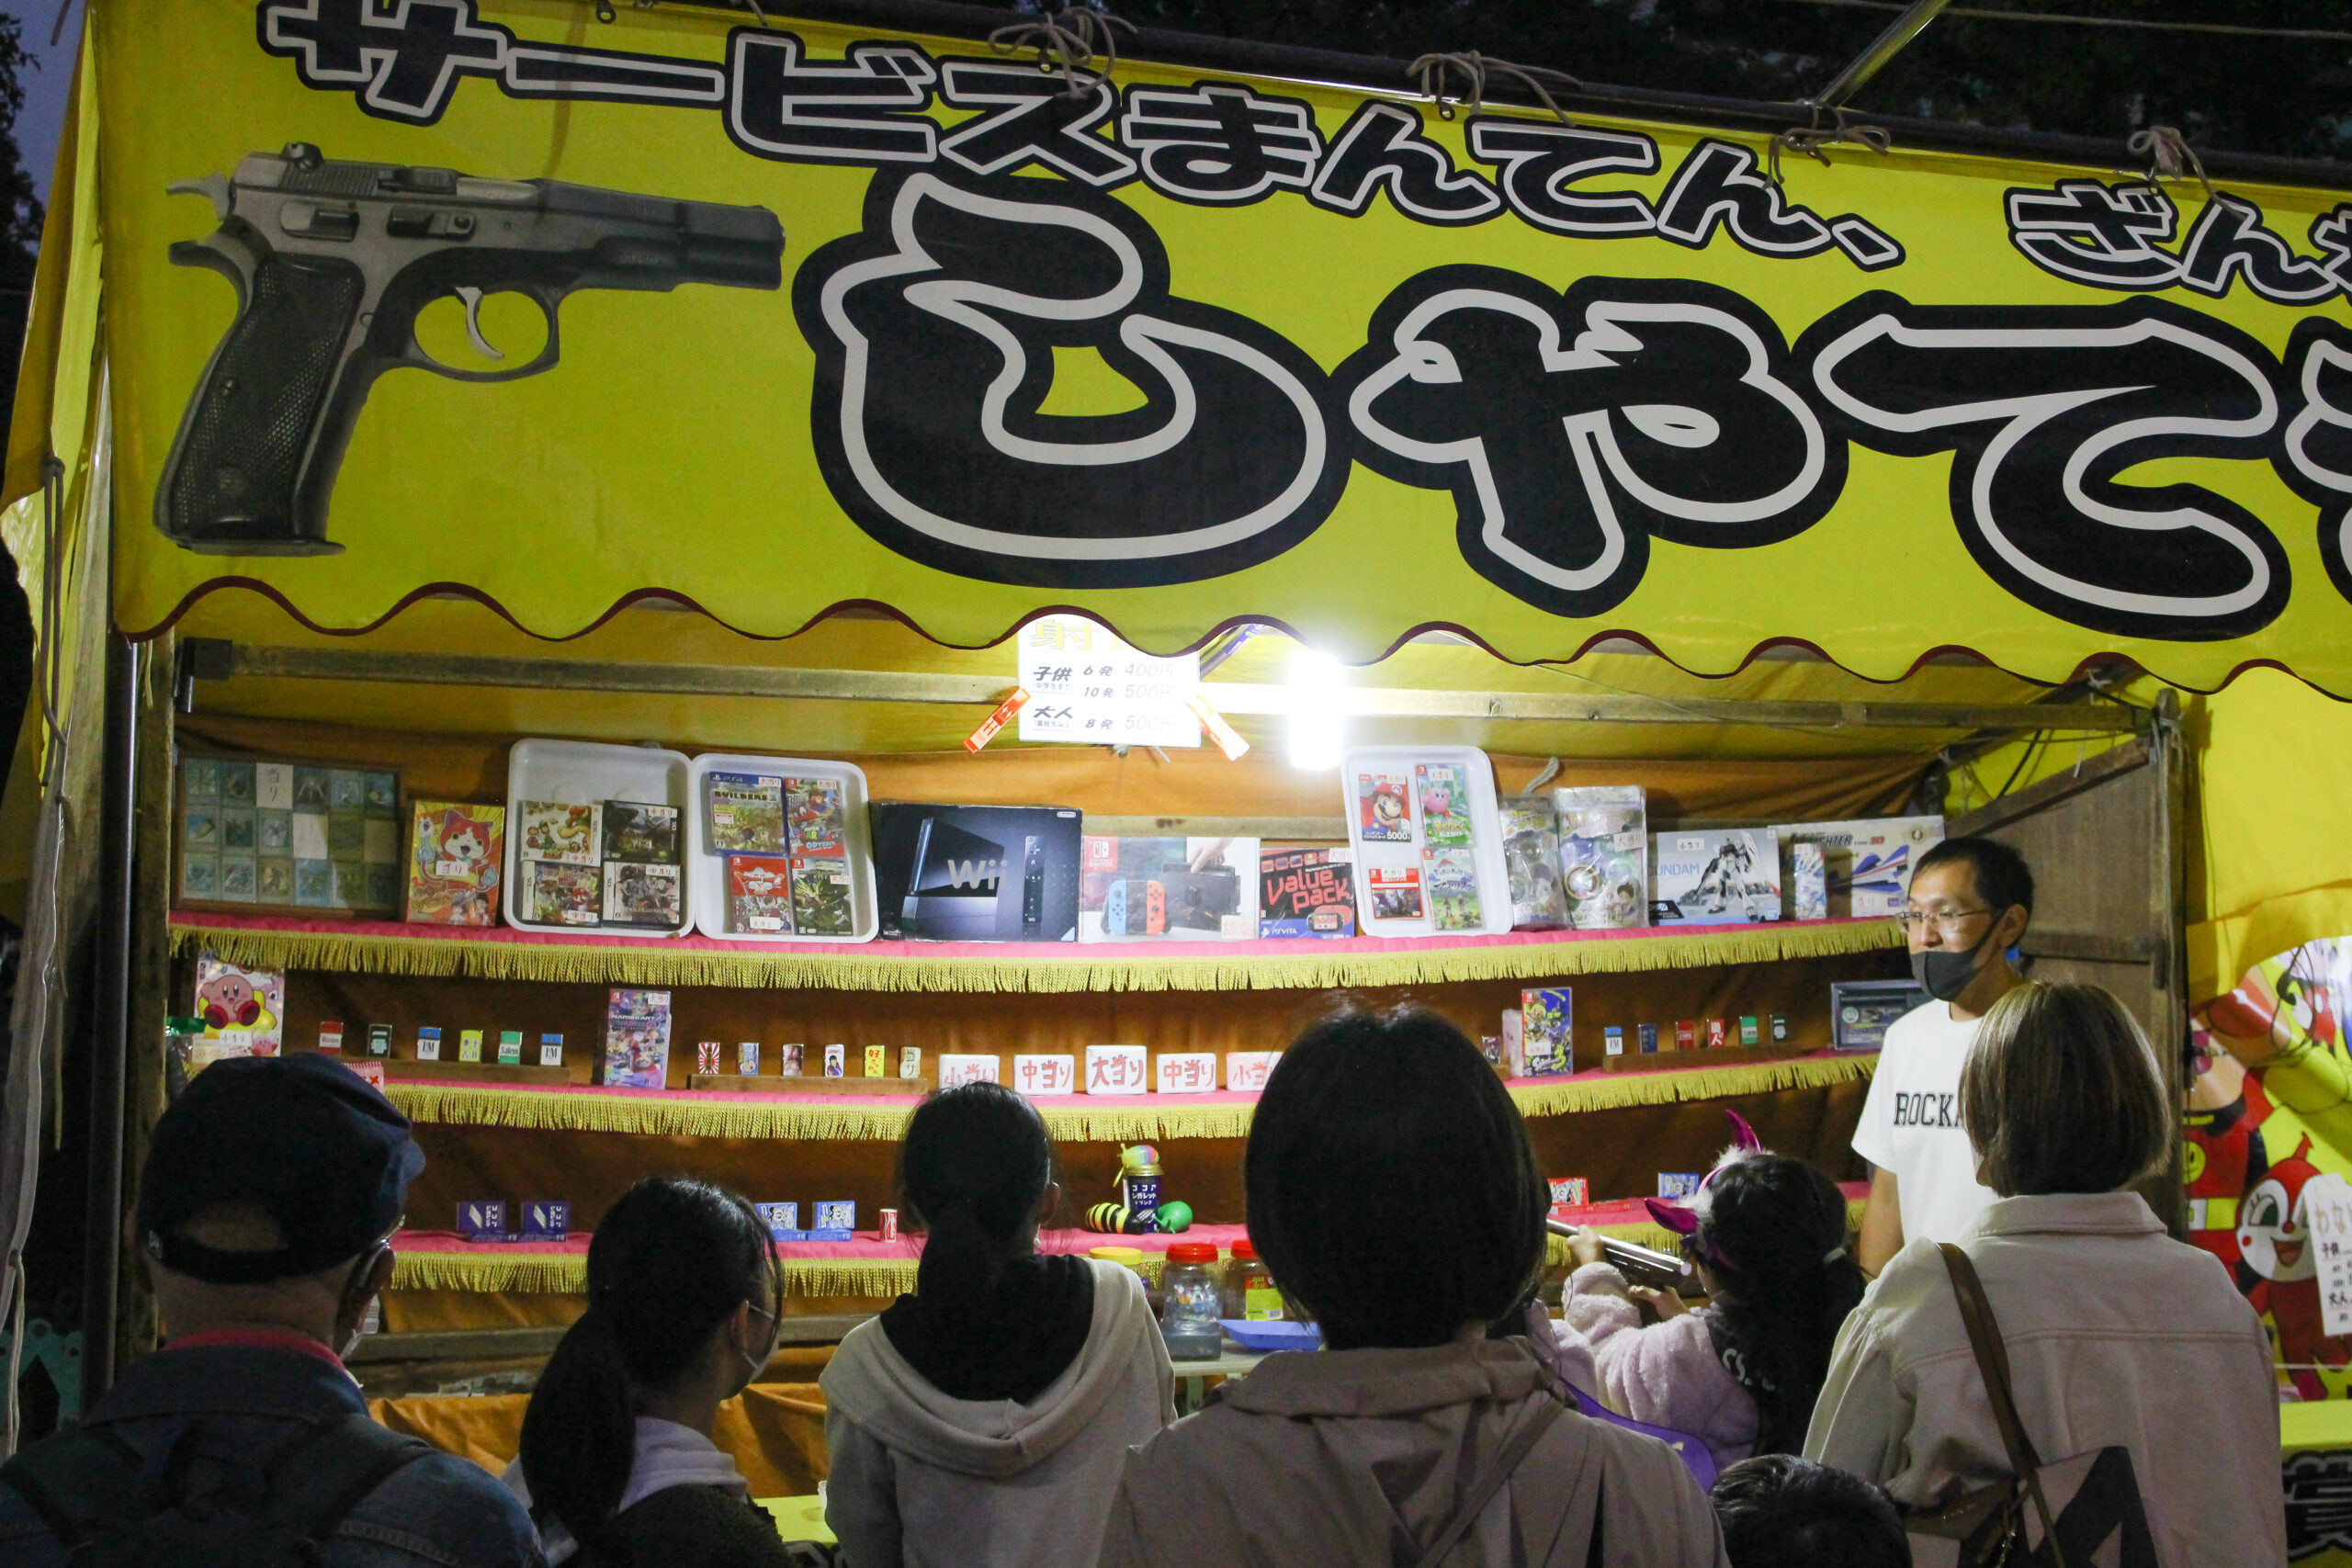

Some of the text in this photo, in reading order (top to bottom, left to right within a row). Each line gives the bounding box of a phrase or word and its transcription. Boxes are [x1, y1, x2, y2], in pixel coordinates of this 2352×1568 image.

[2004, 178, 2352, 309] ざん
[792, 158, 2352, 642] しゃて
[1033, 666, 1073, 682] 子供
[1033, 705, 1074, 719] 大人
[947, 858, 1009, 890] Wii
[1267, 869, 1334, 906] Value
[500, 1046, 519, 1055] Salem
[1022, 1059, 1071, 1089] 中当り
[1091, 1055, 1144, 1088] 大当り
[1162, 1059, 1215, 1088] 中当り
[1232, 1061, 1274, 1086] 小当
[1893, 1092, 1964, 1128] ROCK
[1132, 1184, 1157, 1192] ココア
